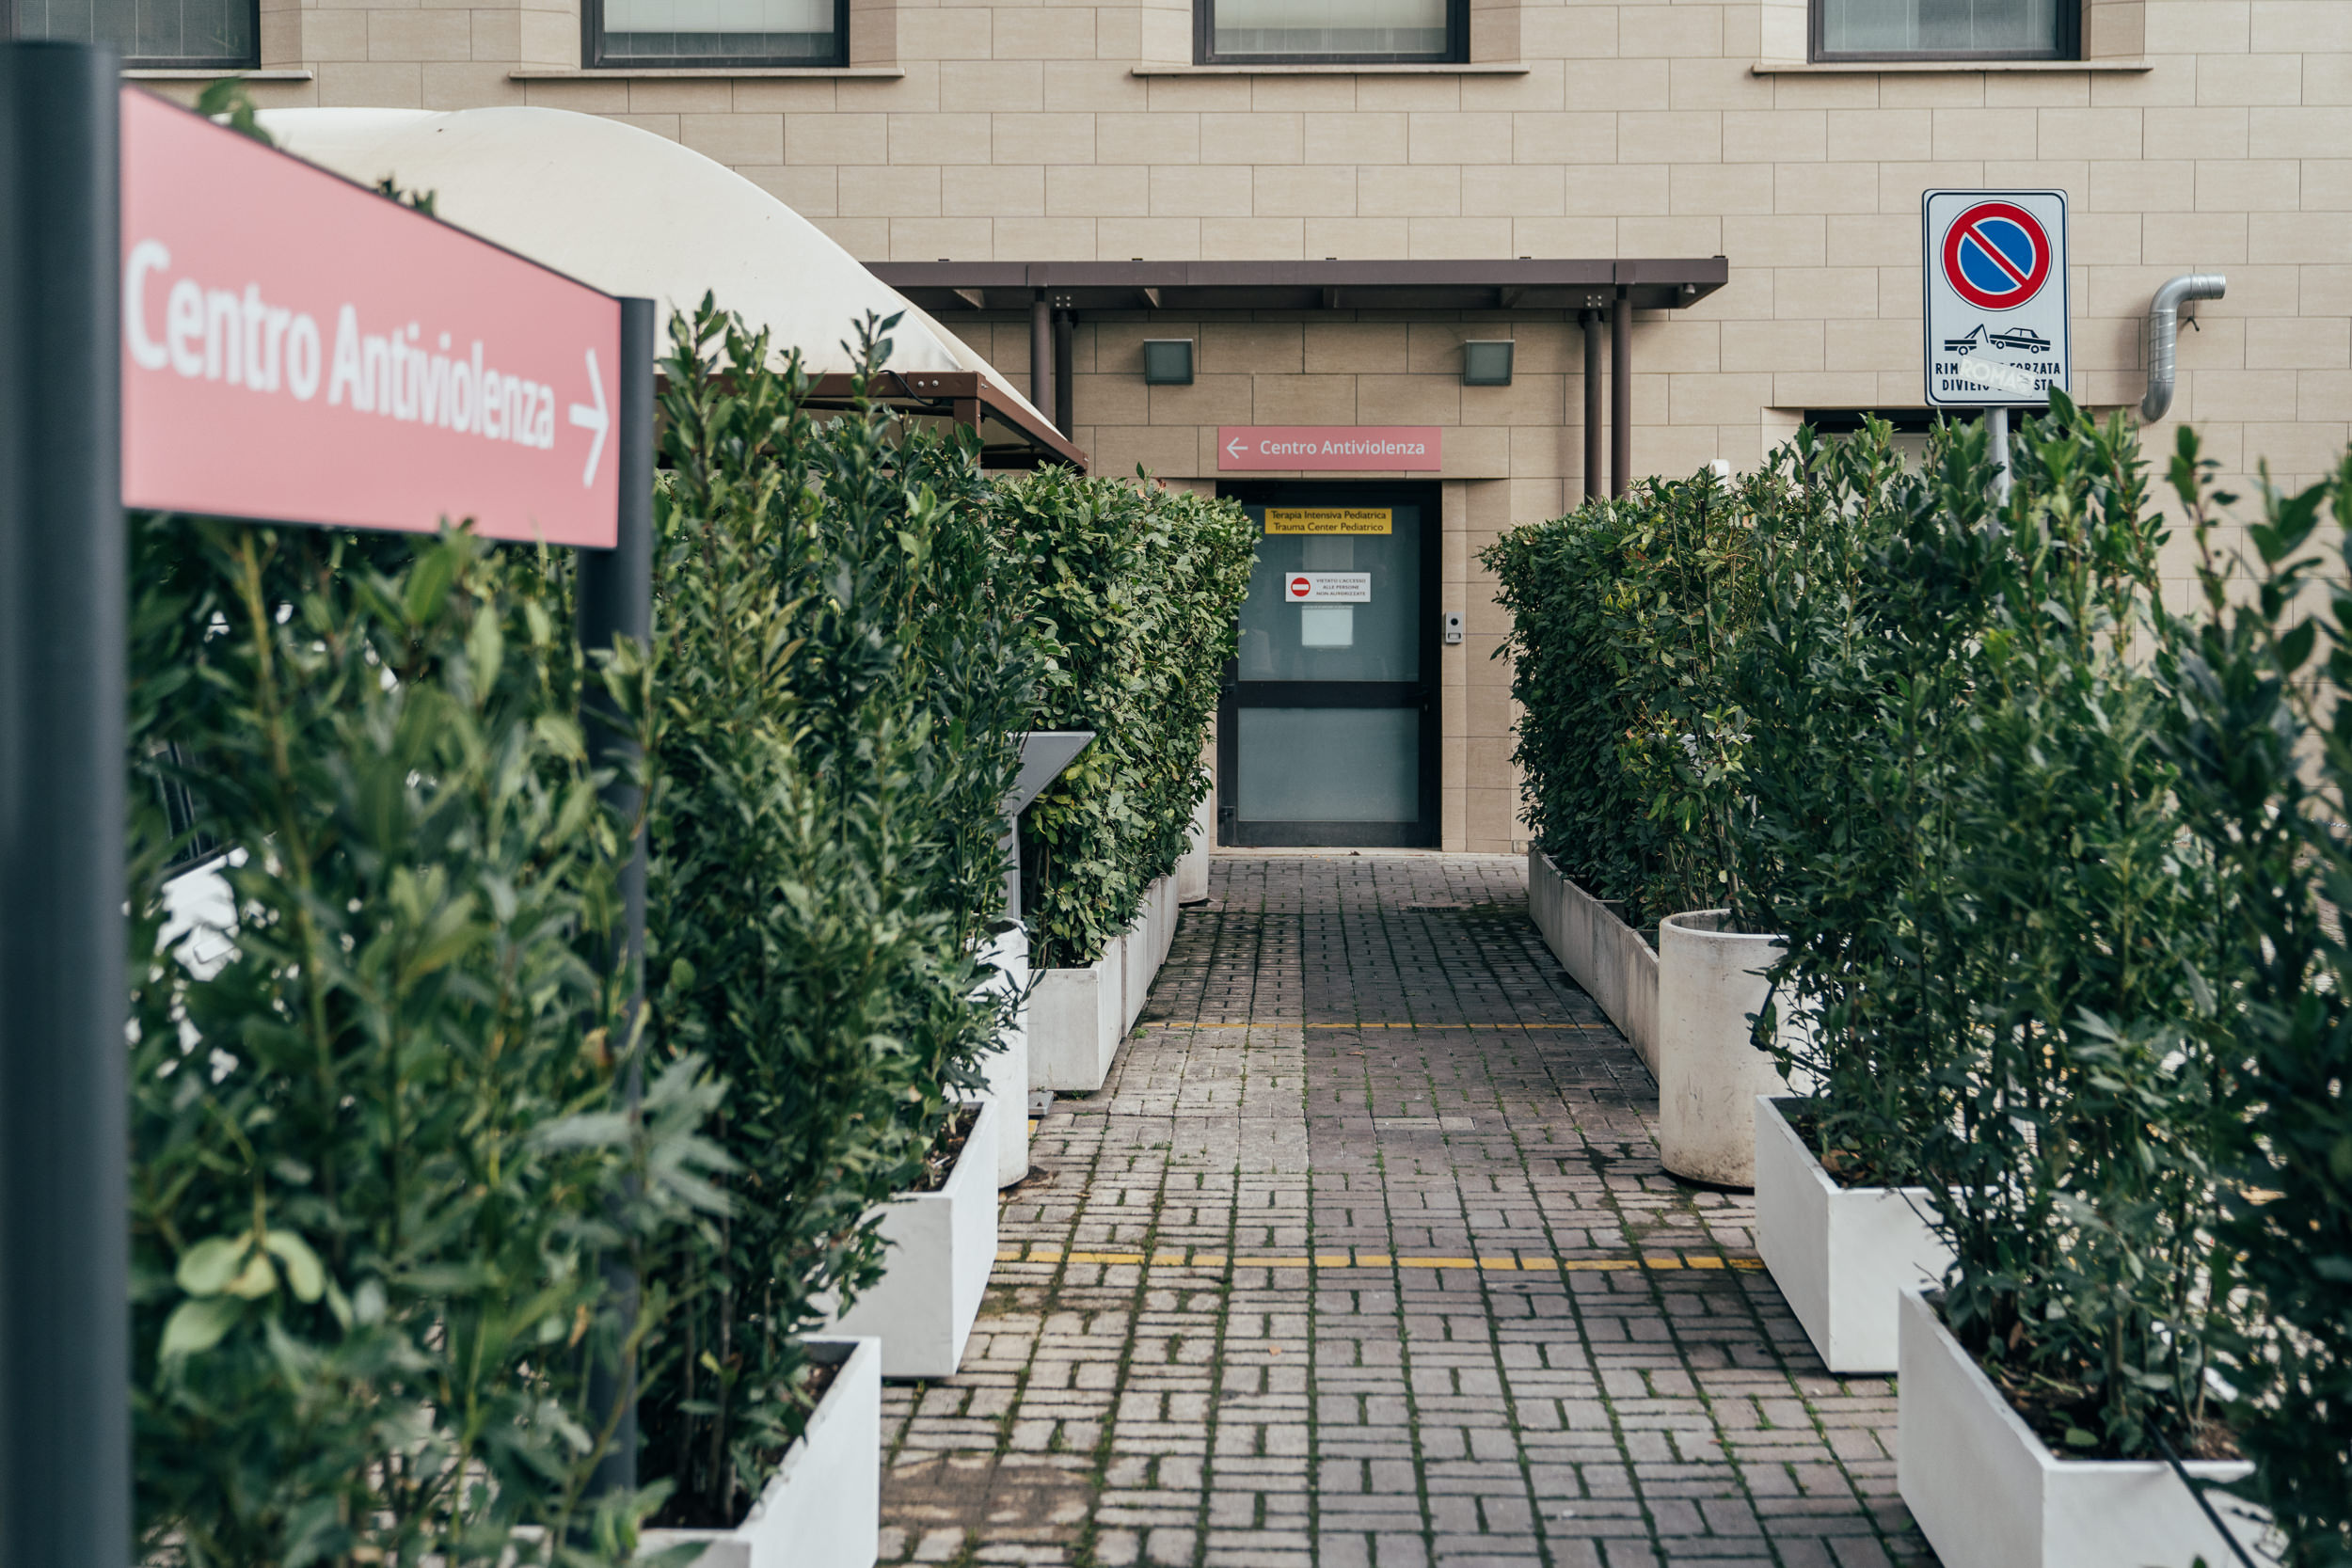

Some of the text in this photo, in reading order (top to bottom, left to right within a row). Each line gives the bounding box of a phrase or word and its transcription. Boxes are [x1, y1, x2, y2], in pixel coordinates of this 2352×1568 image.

[124, 238, 555, 450] Centro Antiviolenza
[2010, 362, 2060, 374] RZATA
[1260, 439, 1425, 455] Centro Antiviolenza
[1271, 510, 1386, 520] Terapia Intensiva Pediatrica
[1274, 522, 1384, 531] Trauma Center Pediatrico
